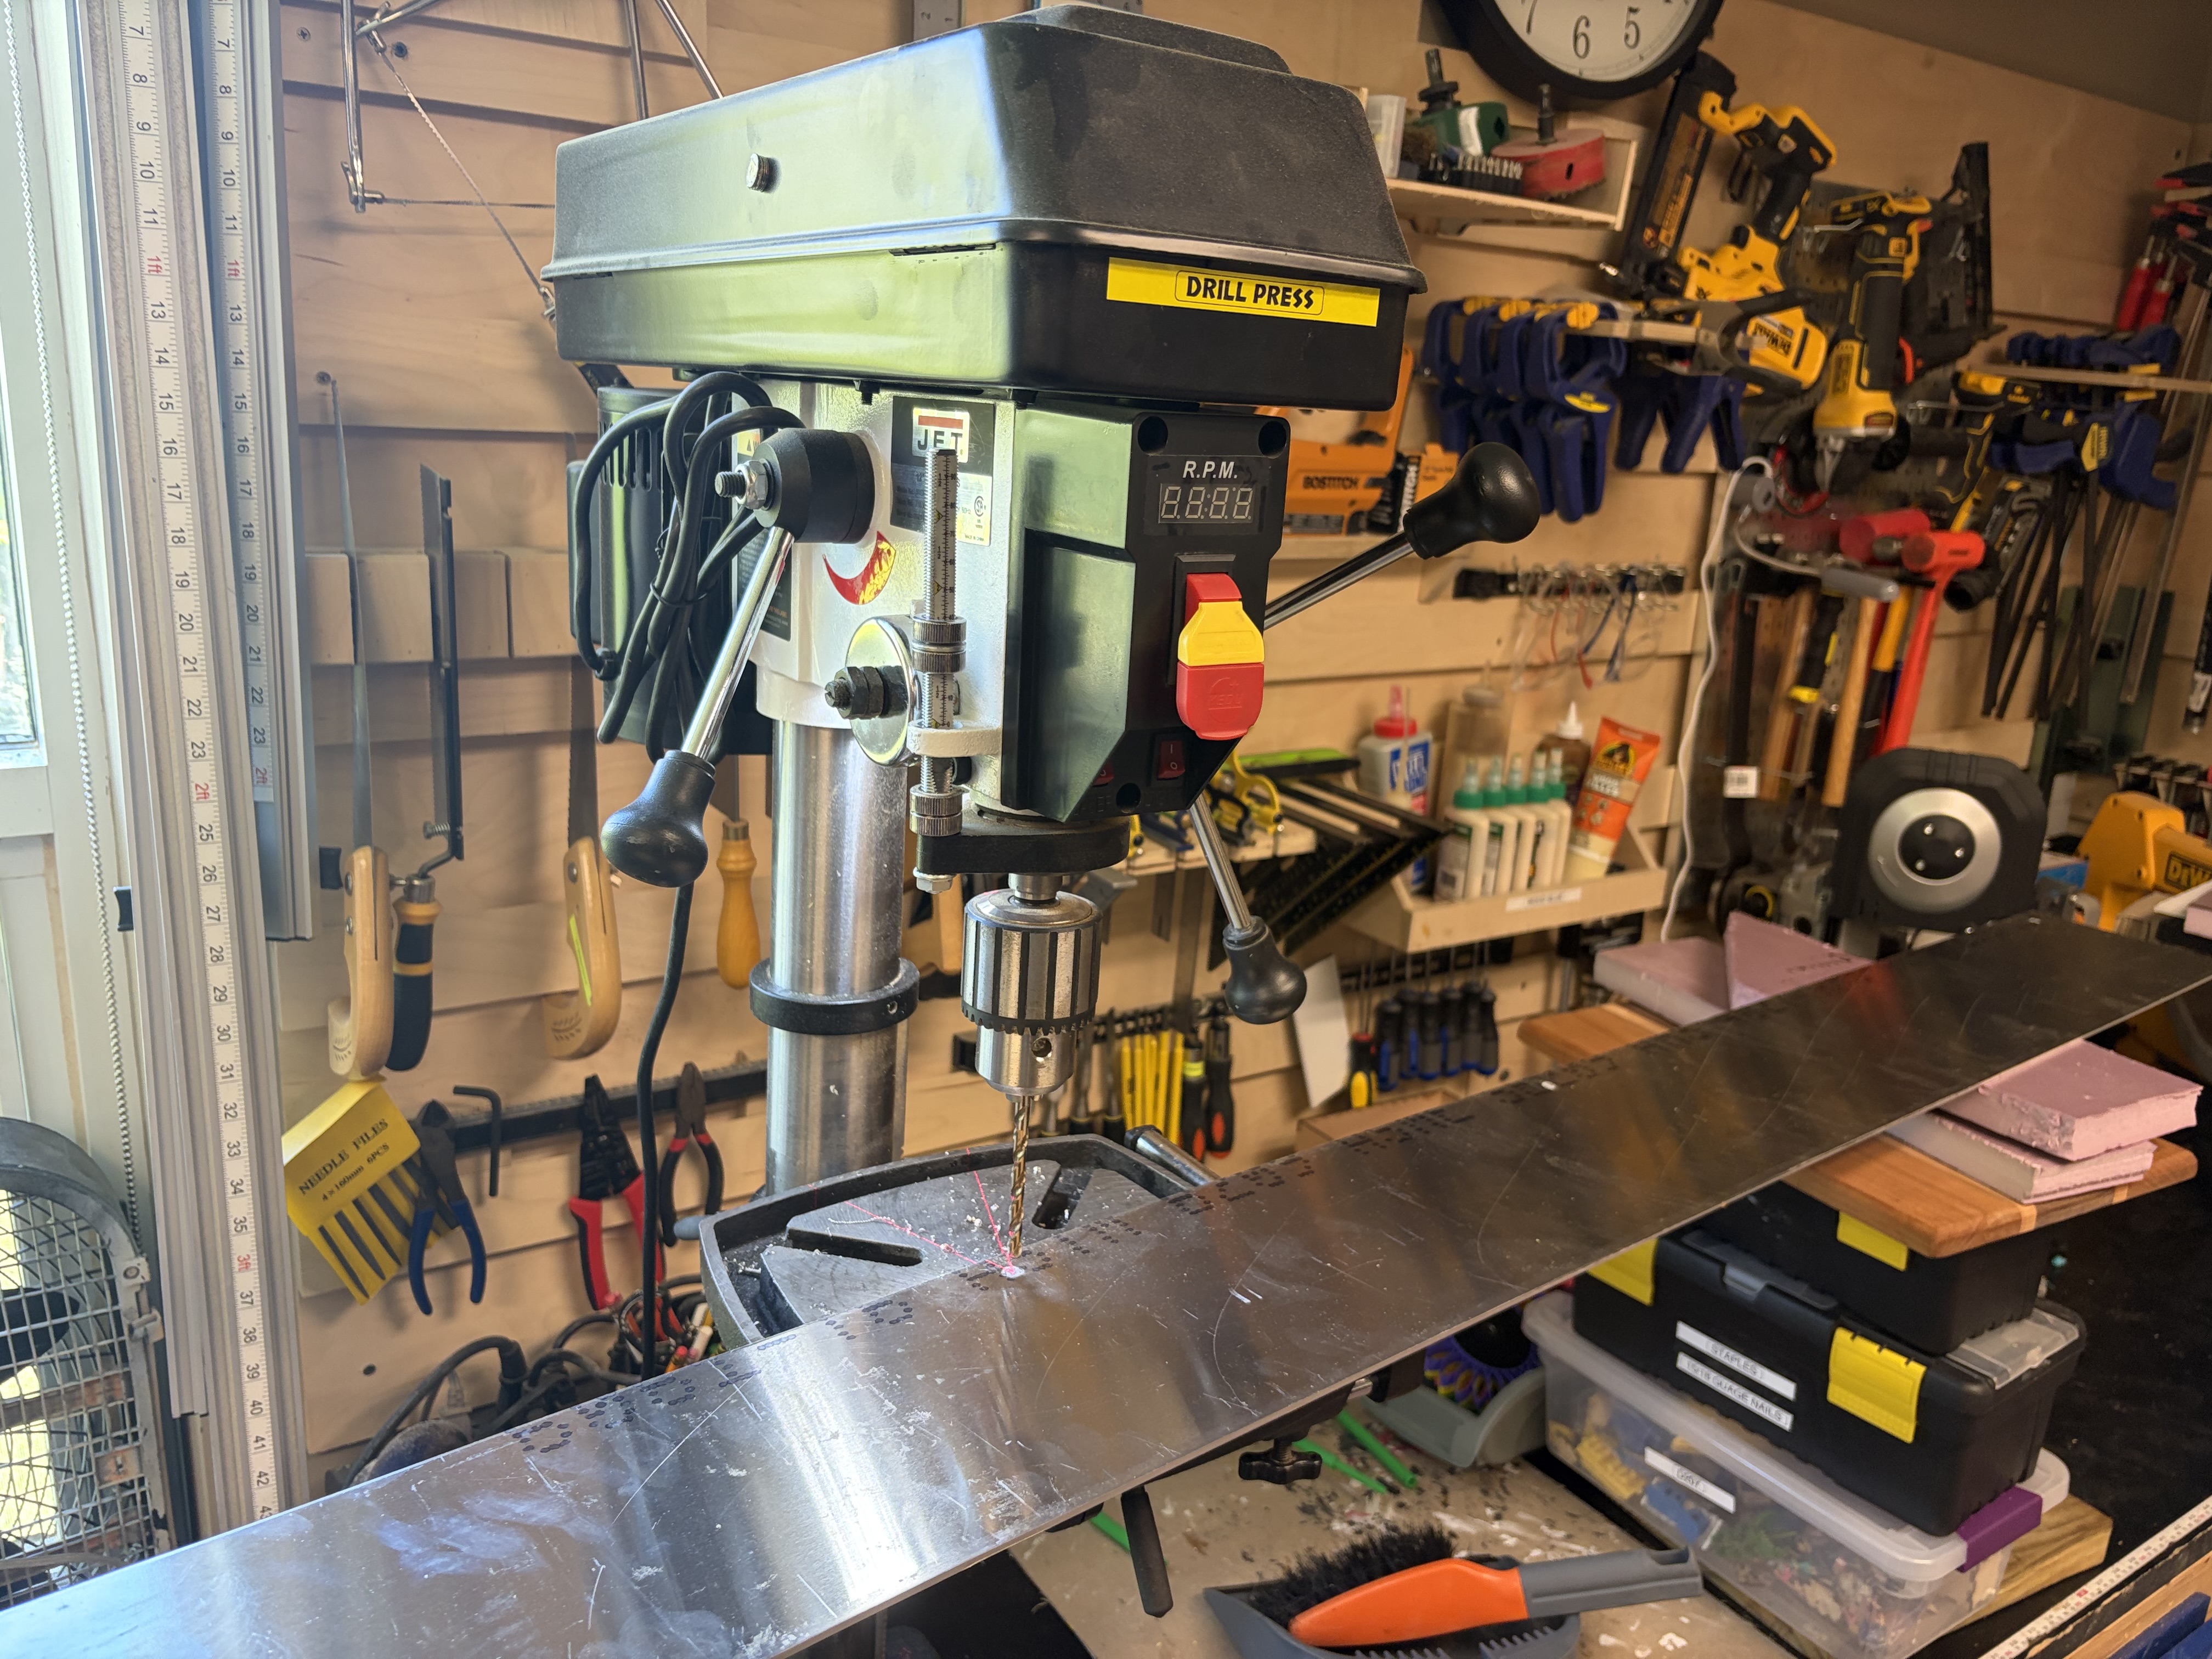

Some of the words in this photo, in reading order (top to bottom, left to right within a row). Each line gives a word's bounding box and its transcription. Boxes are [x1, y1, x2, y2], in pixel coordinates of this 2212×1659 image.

[129, 26, 144, 36] 7
[1624, 5, 1641, 49] 5
[217, 39, 230, 49] 7
[1572, 15, 1590, 59] 6
[133, 74, 148, 83] 8
[219, 85, 232, 94] 8
[137, 121, 151, 132] 9
[221, 131, 234, 140] 9
[140, 161, 155, 179] 10
[223, 169, 235, 187] 10
[143, 208, 158, 225] 11
[224, 215, 237, 230] 11
[147, 256, 162, 274] 1ft
[227, 259, 239, 277] 1ft
[1186, 276, 1246, 302] DRILL
[1252, 284, 1314, 309] PRESS
[151, 301, 166, 319] 13
[230, 304, 242, 321] 13
[154, 347, 170, 365] 14
[232, 349, 244, 365] 14
[159, 393, 174, 411] 15
[234, 393, 247, 410] 15
[162, 438, 178, 455] 16
[237, 436, 250, 454] 16
[917, 429, 963, 452] JET
[1183, 460, 1238, 479] R.P.M.
[239, 479, 252, 496] 17
[1303, 476, 1359, 489] BOSTITCH
[166, 483, 182, 500] 17
[171, 526, 186, 544] 18
[242, 522, 254, 539] 18
[175, 571, 190, 588] 19
[244, 565, 257, 581] 19
[179, 613, 194, 631] 20
[246, 605, 259, 623] 20
[249, 645, 261, 662] 21
[183, 656, 198, 673] 21
[251, 686, 263, 705] 22
[187, 698, 202, 717] 22
[253, 727, 266, 744] 23
[191, 741, 206, 759] 23
[255, 767, 268, 785] 2ft
[195, 783, 210, 800] 2ft
[199, 825, 214, 842] 25
[202, 865, 217, 882] 26
[206, 906, 221, 922] 27
[210, 946, 224, 963] 28
[213, 985, 228, 1002] 29
[216, 1025, 231, 1042] 30
[220, 1064, 234, 1080] 31
[223, 1102, 238, 1119] 32
[227, 1141, 241, 1157] 33
[298, 1149, 349, 1195] NEEDLE
[352, 1118, 388, 1150] FILES
[230, 1178, 244, 1195] 34
[233, 1216, 247, 1233] 35
[236, 1254, 251, 1272] 3ft
[240, 1291, 255, 1306] 37
[243, 1327, 257, 1343] 38
[1711, 1342, 1758, 1375] STAPLES
[246, 1363, 260, 1380] 39
[249, 1400, 263, 1415] 40
[1750, 1398, 1784, 1422] NAILS
[253, 1435, 267, 1450] 41
[256, 1470, 270, 1486] 42
